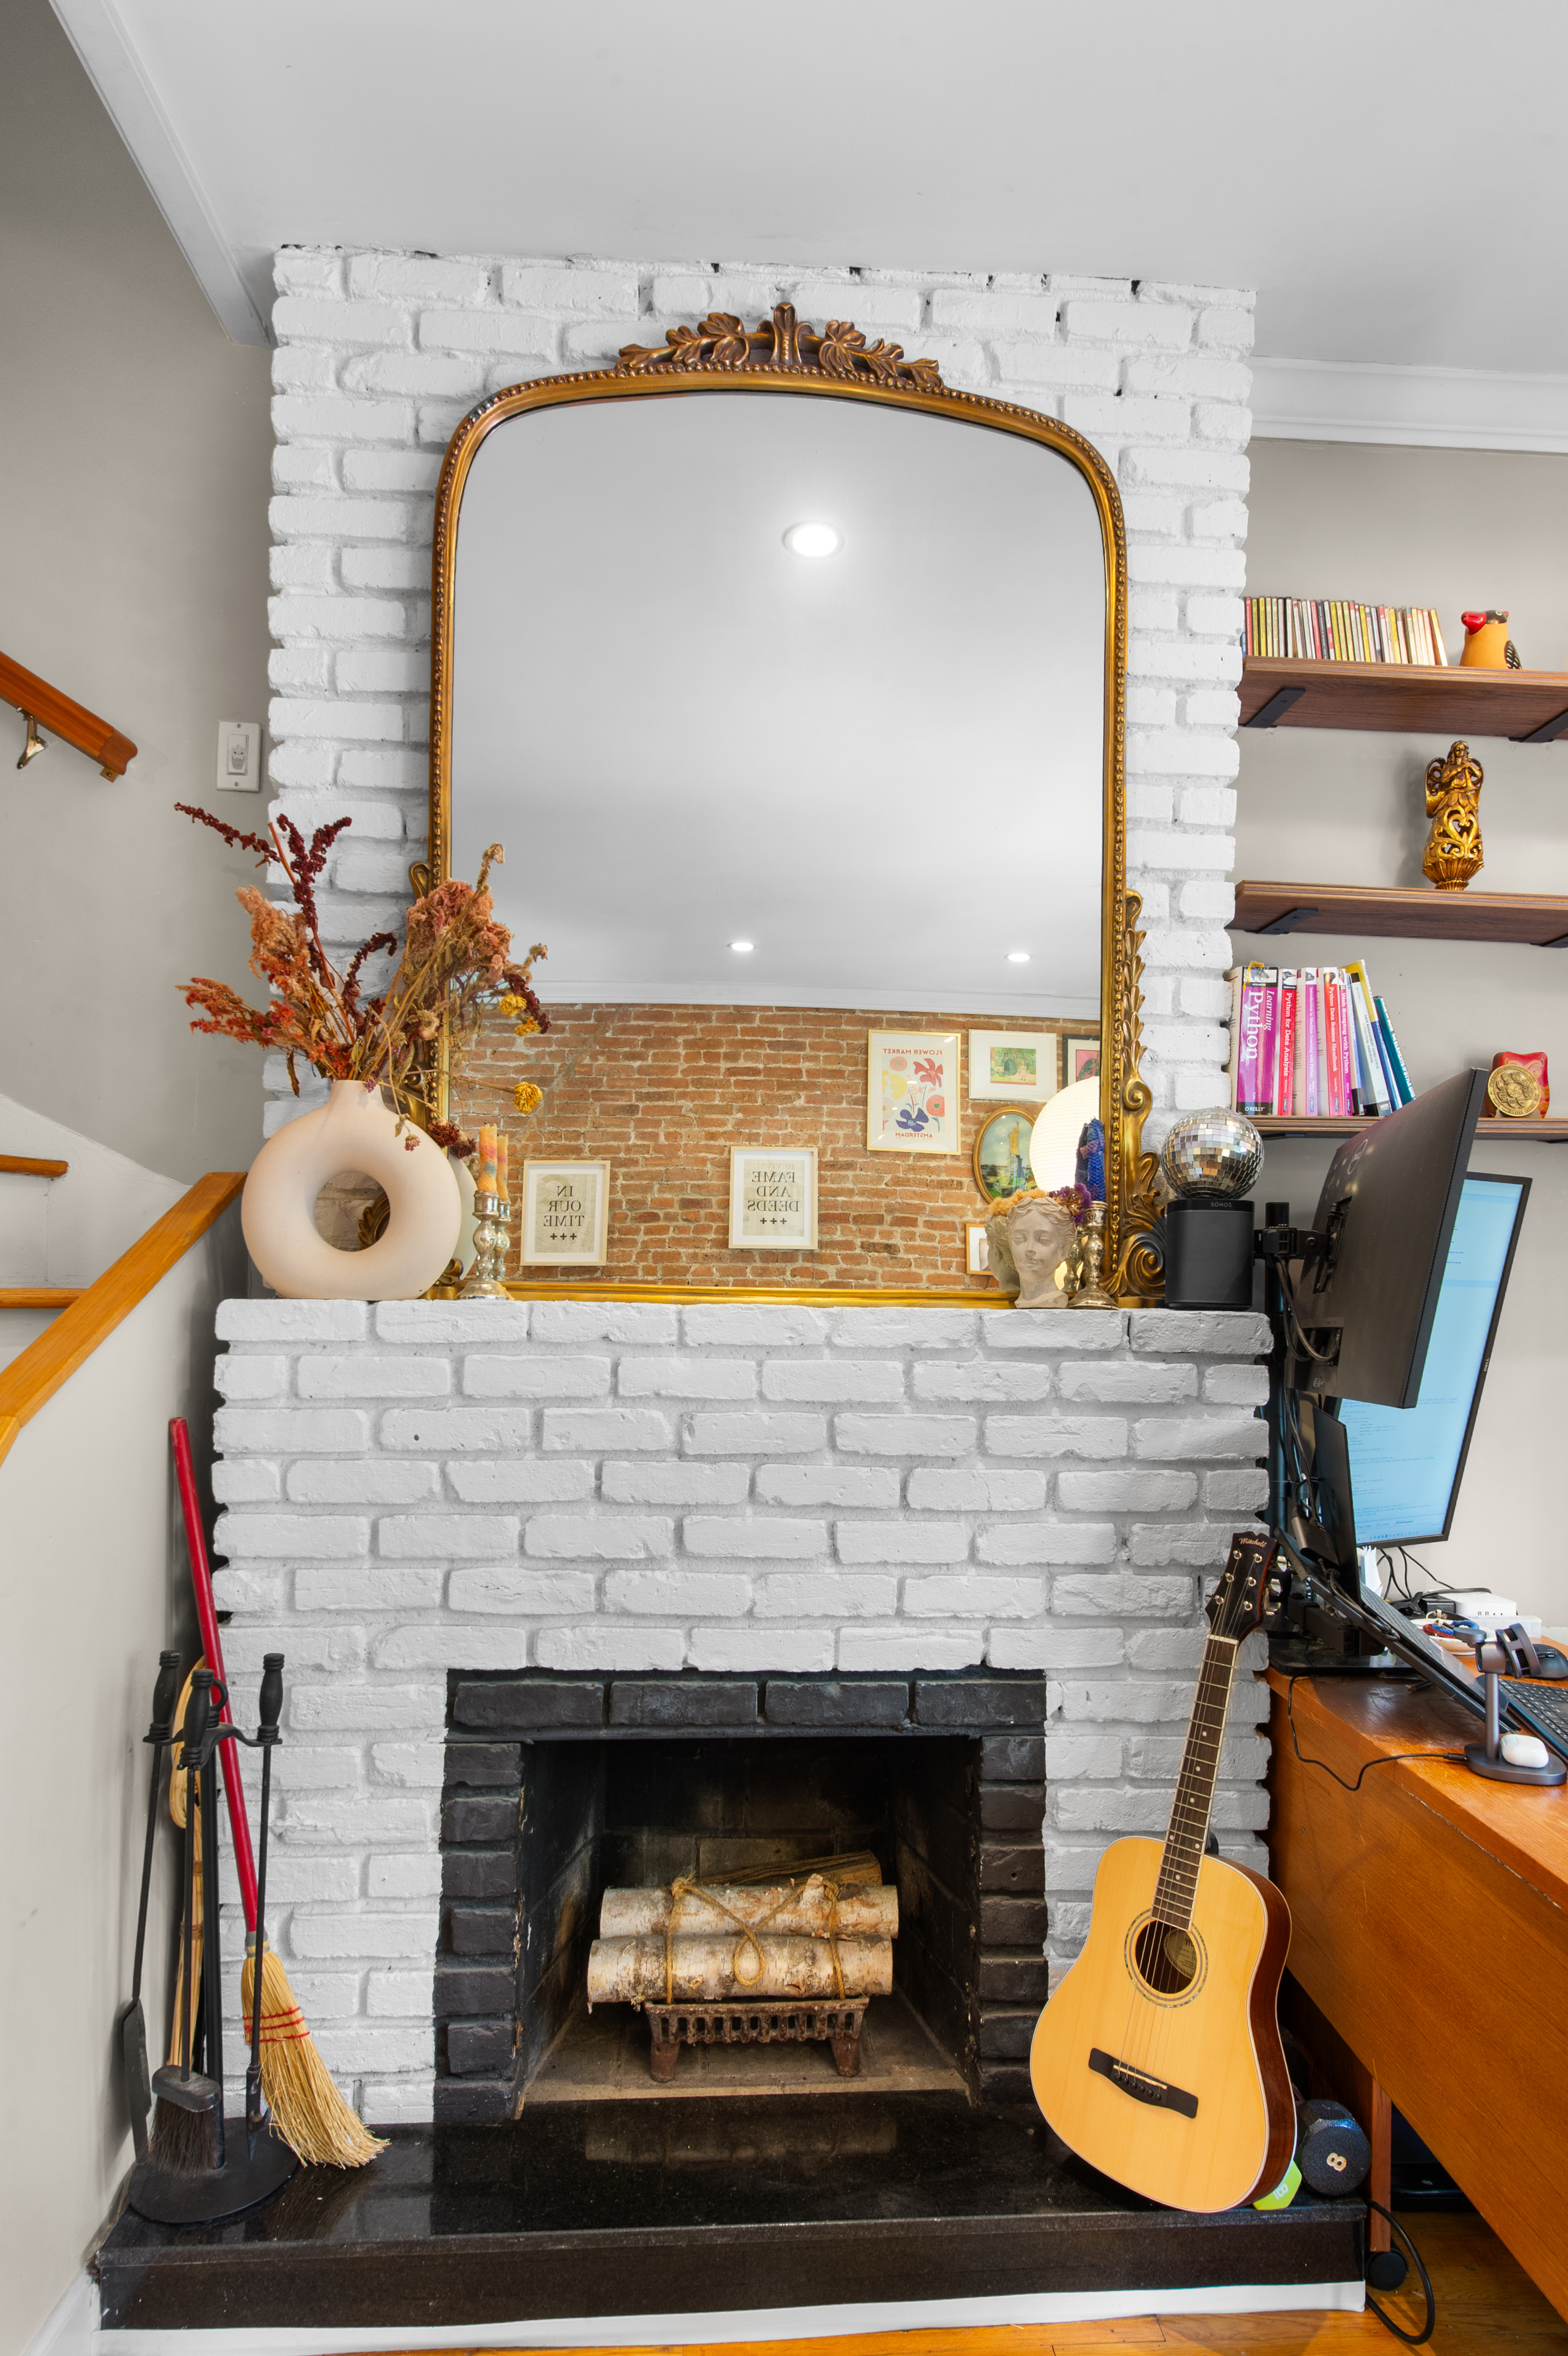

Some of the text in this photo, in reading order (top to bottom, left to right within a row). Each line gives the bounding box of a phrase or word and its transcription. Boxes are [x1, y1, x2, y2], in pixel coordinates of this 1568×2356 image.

[1244, 990, 1263, 1059] Python
[1263, 990, 1274, 1031] Learning
[1394, 1041, 1405, 1067] ELEMENTS
[1404, 1071, 1412, 1087] STYLE
[1239, 1538, 1267, 1548] Mitchell
[1326, 2152, 1347, 2171] 8
